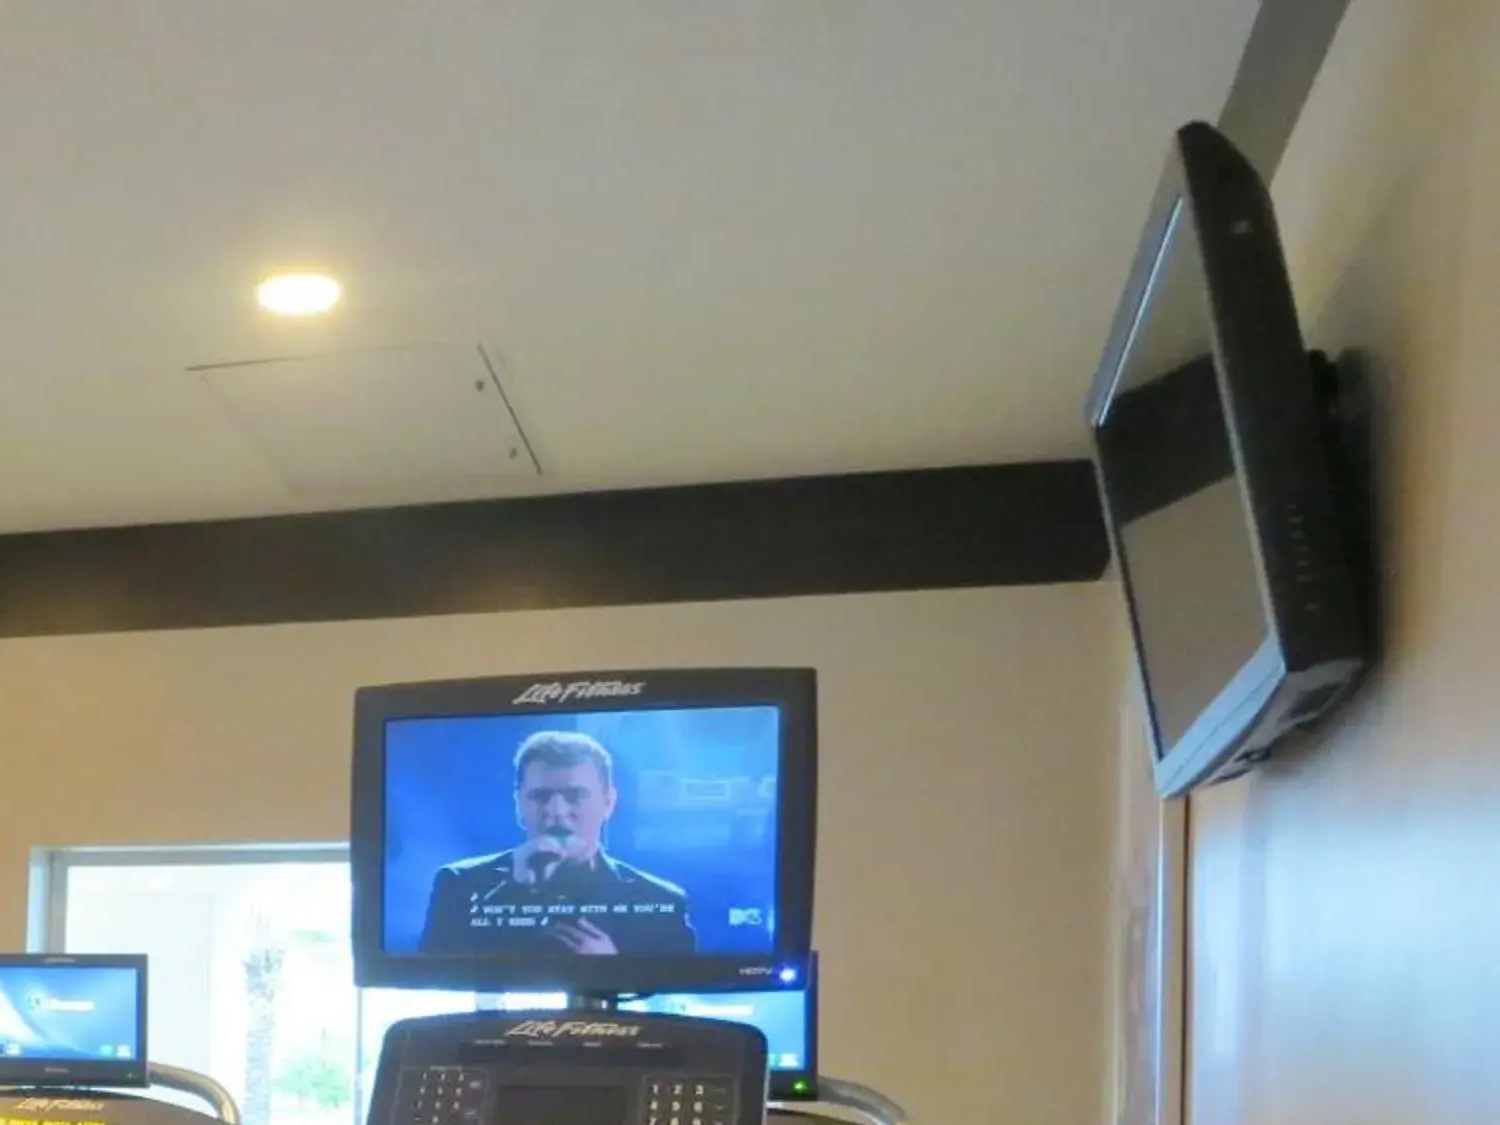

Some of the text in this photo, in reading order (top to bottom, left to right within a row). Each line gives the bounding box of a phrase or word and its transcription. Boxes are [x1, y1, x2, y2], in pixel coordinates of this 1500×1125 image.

[511, 680, 647, 704] Life Fitness
[504, 1020, 641, 1038] Life Fitness
